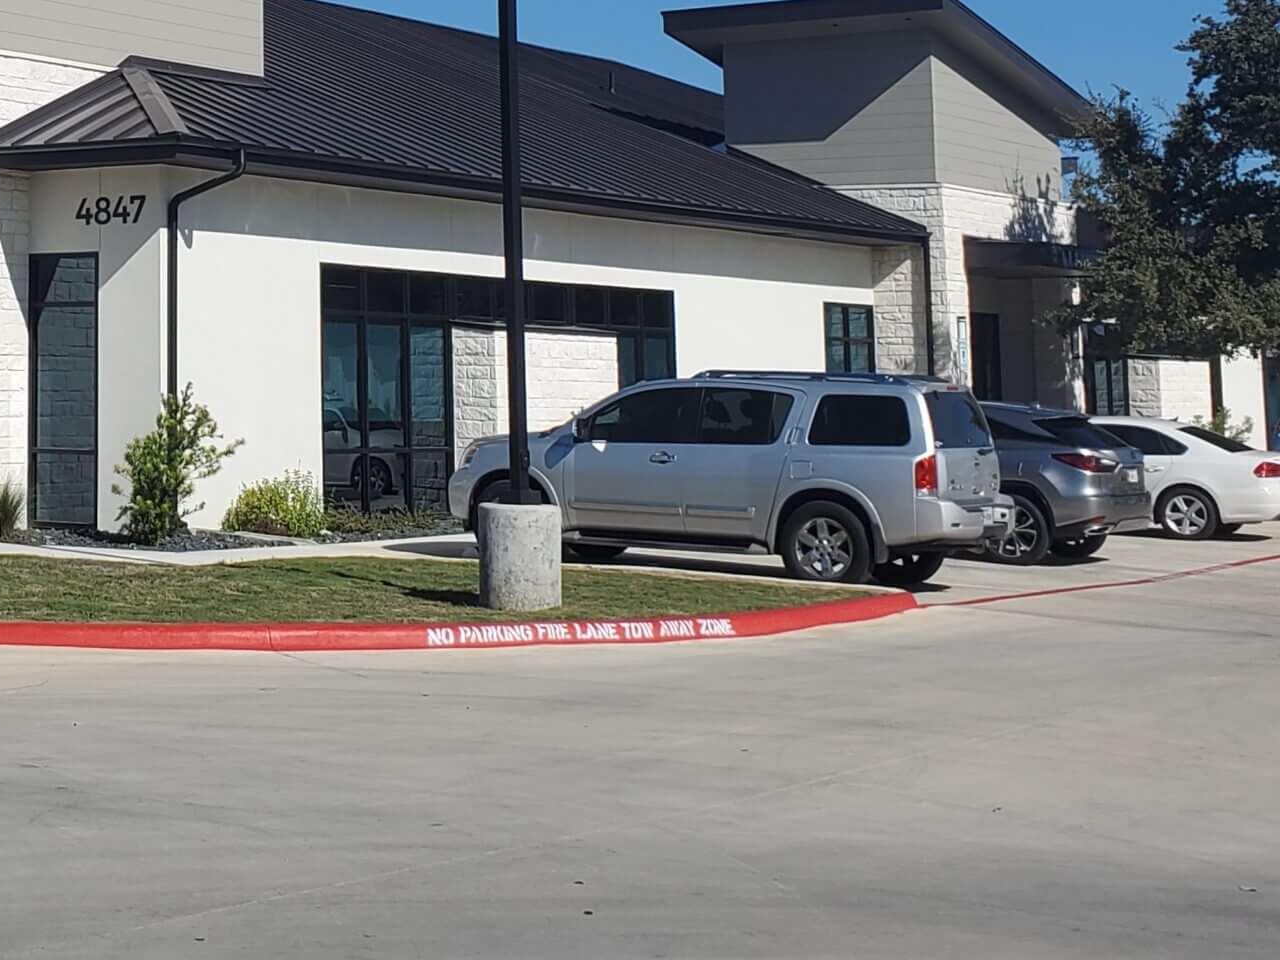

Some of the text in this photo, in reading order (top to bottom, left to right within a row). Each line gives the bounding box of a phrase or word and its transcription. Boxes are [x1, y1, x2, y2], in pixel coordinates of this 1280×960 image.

[75, 195, 146, 226] 4847
[427, 618, 736, 646] NO PARKING FIRE LANE TOW AWAY ZONE
